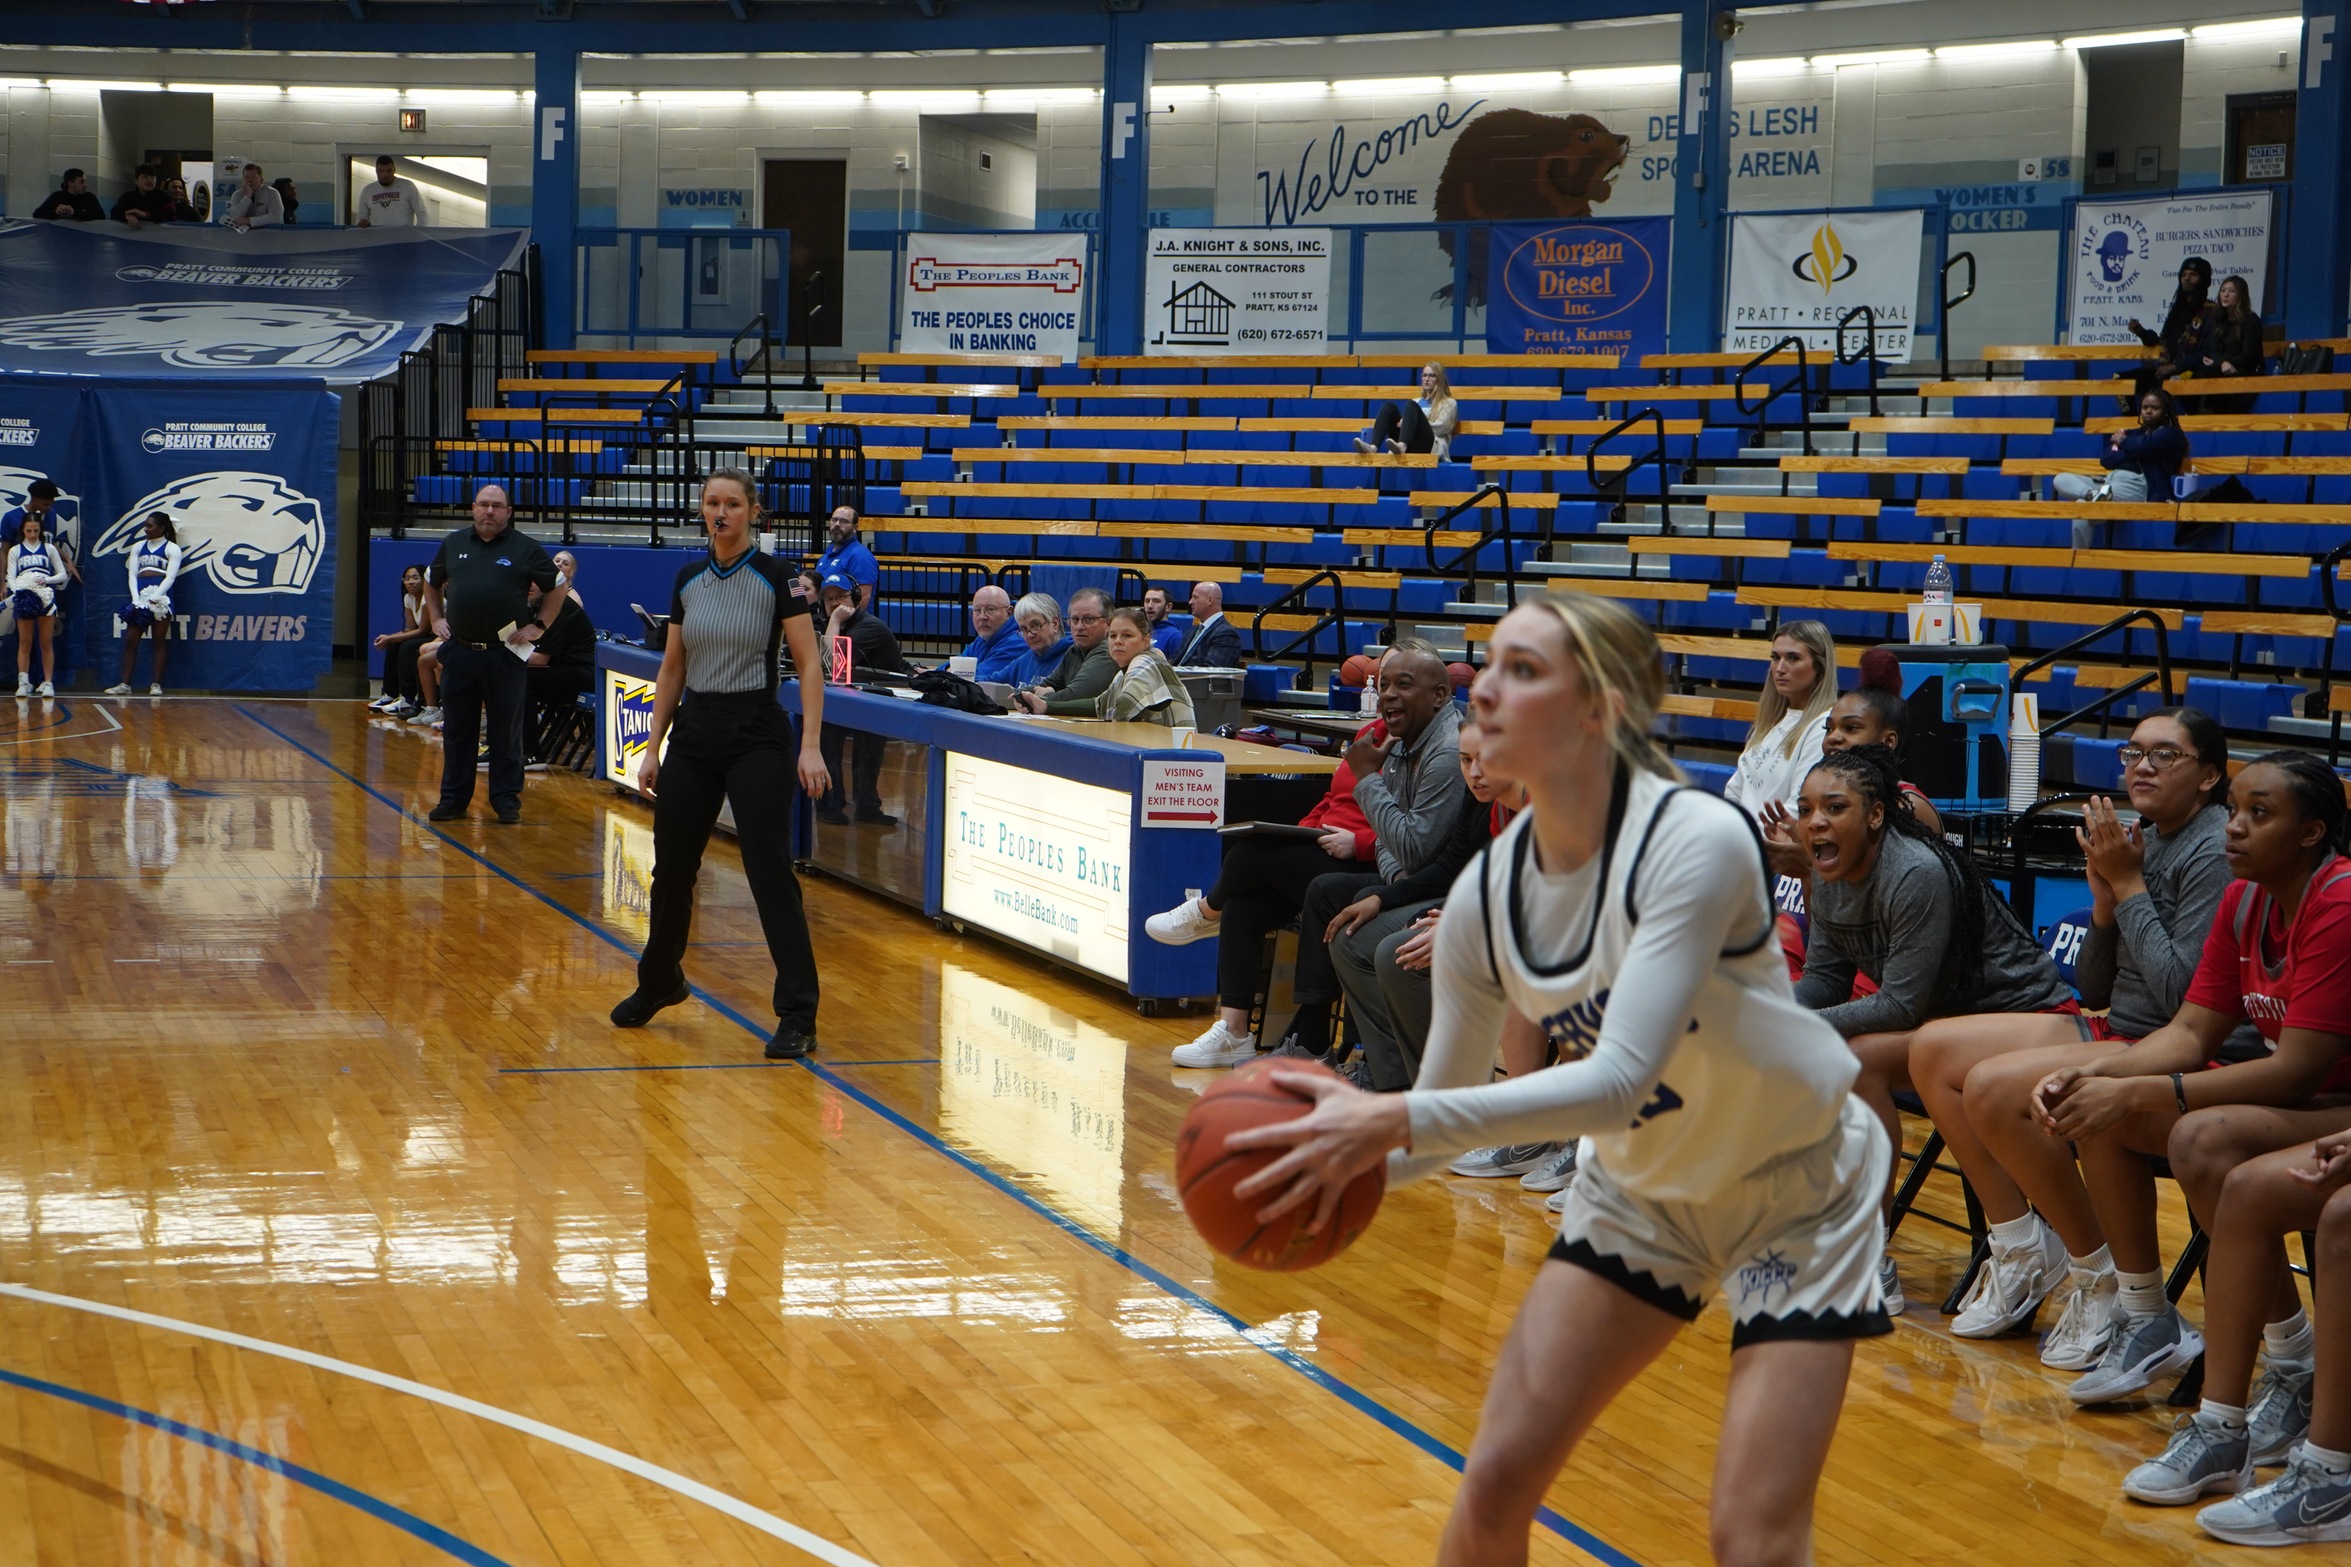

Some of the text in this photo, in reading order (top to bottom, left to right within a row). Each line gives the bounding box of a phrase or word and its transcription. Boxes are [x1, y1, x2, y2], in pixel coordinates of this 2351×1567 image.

[2305, 15, 2337, 89] F
[1684, 72, 1711, 135] F
[1749, 106, 1818, 137] LESH
[541, 107, 566, 160] F
[1112, 102, 1137, 159] F
[2248, 146, 2284, 157] NOTICE
[1257, 99, 1489, 226] Welcome
[1737, 150, 1820, 178] ARENA
[2045, 160, 2070, 178] 58
[666, 191, 742, 206] WOMEN
[1355, 190, 1417, 205] TO THE
[1934, 186, 2036, 206] WOMEN'S
[1949, 210, 2027, 231] OCKER
[2081, 213, 2149, 260] THE CHAPEAU
[2155, 226, 2264, 242] BURGERS, SANDWICHES
[1156, 241, 1325, 254] J.A. KNIGHT & SONS, INC.
[1533, 238, 1624, 267] Morgan
[2183, 242, 2234, 255] PIZZA TACO
[165, 263, 340, 276] PRATT COMMUNITY COLLEGE
[1173, 264, 1305, 273] GENERAL CONTRACTORS
[154, 269, 342, 288] BEAVER BACKERS
[1538, 267, 1612, 296] Diesel
[2086, 271, 2105, 291] FOOD
[2115, 269, 2140, 293] DRINK
[1246, 304, 1318, 312] PRATT, KS 67124
[1564, 300, 1596, 315] Inc.
[1737, 307, 1789, 320] PRATT
[911, 311, 1076, 330] THE PEOPLES CHOICE
[2080, 317, 2095, 327] 701
[950, 333, 1036, 350] IN BANKING
[1237, 329, 1323, 341] (620) 672-6571
[1524, 327, 1632, 343] Pratt, Kansas
[1, 418, 30, 427] COLLEGE
[165, 423, 267, 432] PRATT COMMUNITY COLLEGE
[165, 434, 271, 449] BEAVER BACKERS
[18, 554, 49, 569] PRATT
[139, 555, 169, 569] PRATT
[195, 615, 307, 642] BEAVERS
[1164, 768, 1204, 777] VISITING
[1155, 783, 1212, 792] MEN'S TEAM
[1147, 797, 1219, 807] EXIT THE FLOOR
[993, 889, 1079, 934] www.BelleBank.com
